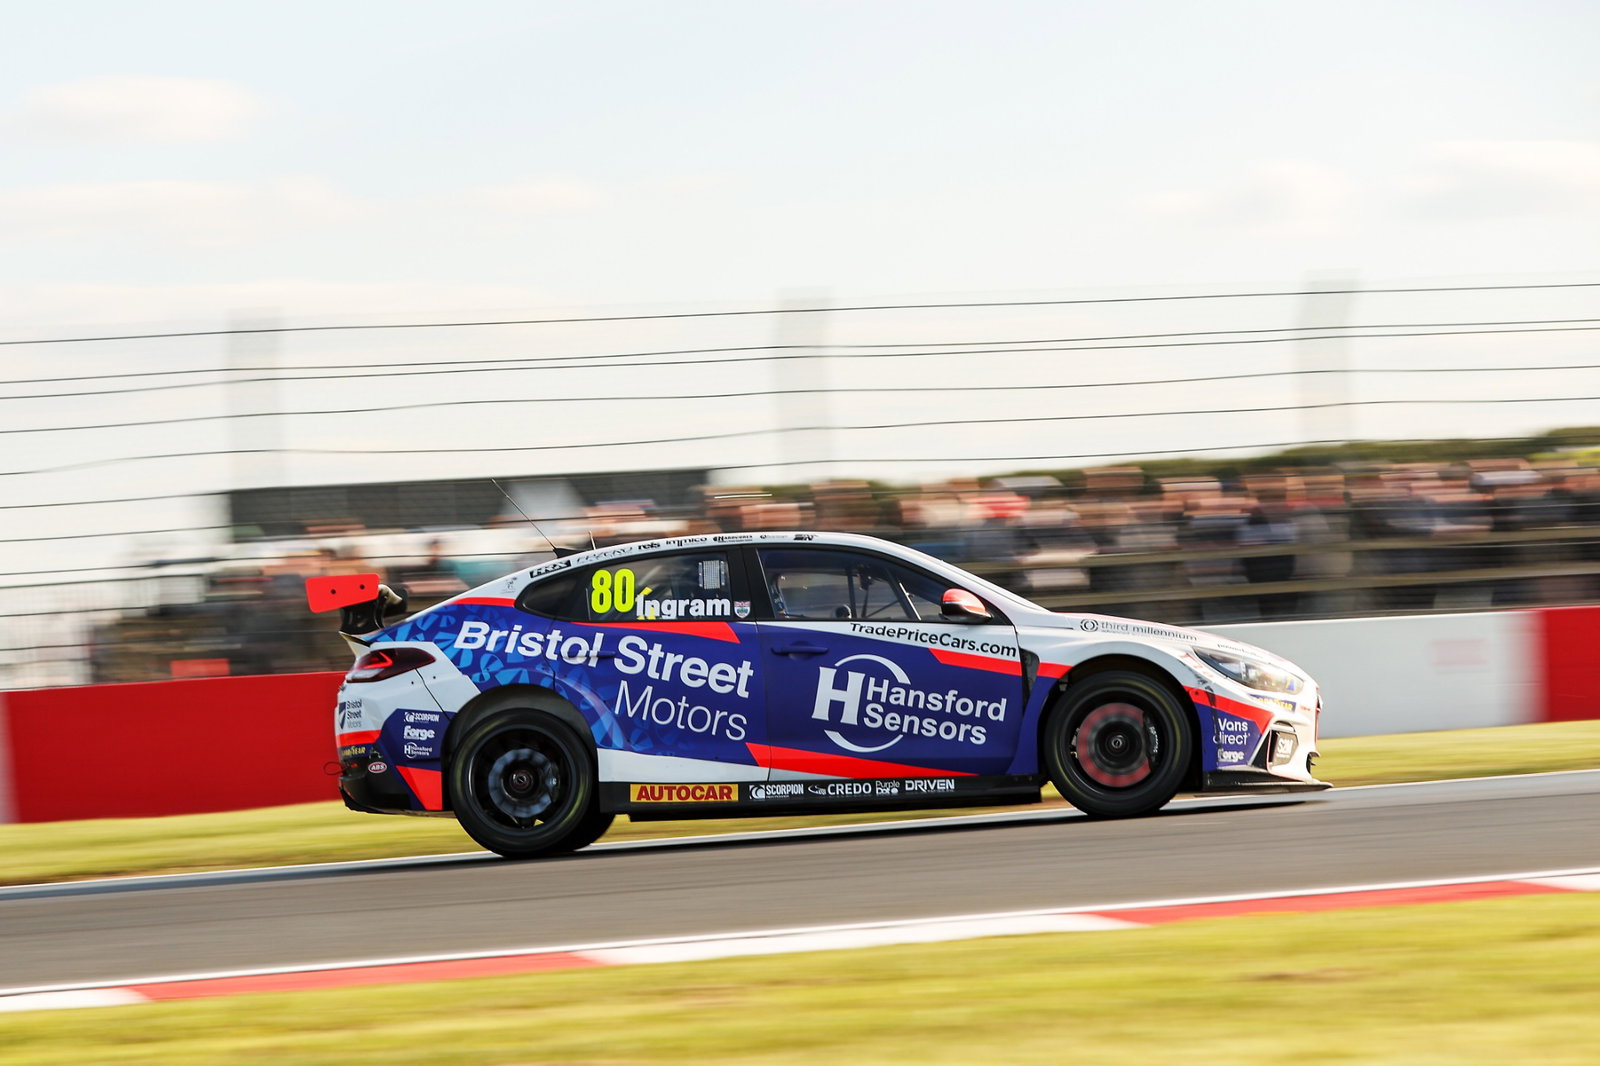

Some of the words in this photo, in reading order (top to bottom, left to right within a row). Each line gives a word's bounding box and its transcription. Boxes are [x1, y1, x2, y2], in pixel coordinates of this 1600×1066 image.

[591, 568, 635, 614] 80
[636, 594, 731, 619] Ingram
[850, 622, 1017, 657] TradePriceCars.com
[1101, 621, 1129, 632] third
[1132, 626, 1198, 642] millennium
[453, 620, 604, 667] Bristol
[614, 635, 754, 699] Street
[866, 676, 1007, 722] Hansford
[614, 680, 748, 741] Motors
[404, 725, 435, 740] Forge
[863, 702, 987, 745] Sensors
[1217, 718, 1248, 732] Vans
[636, 785, 734, 801] AUTOCAR
[766, 783, 804, 795] SCORPION
[827, 782, 872, 796] CREDO
[875, 780, 900, 789] Purple
[905, 778, 955, 793] DRIVEN
